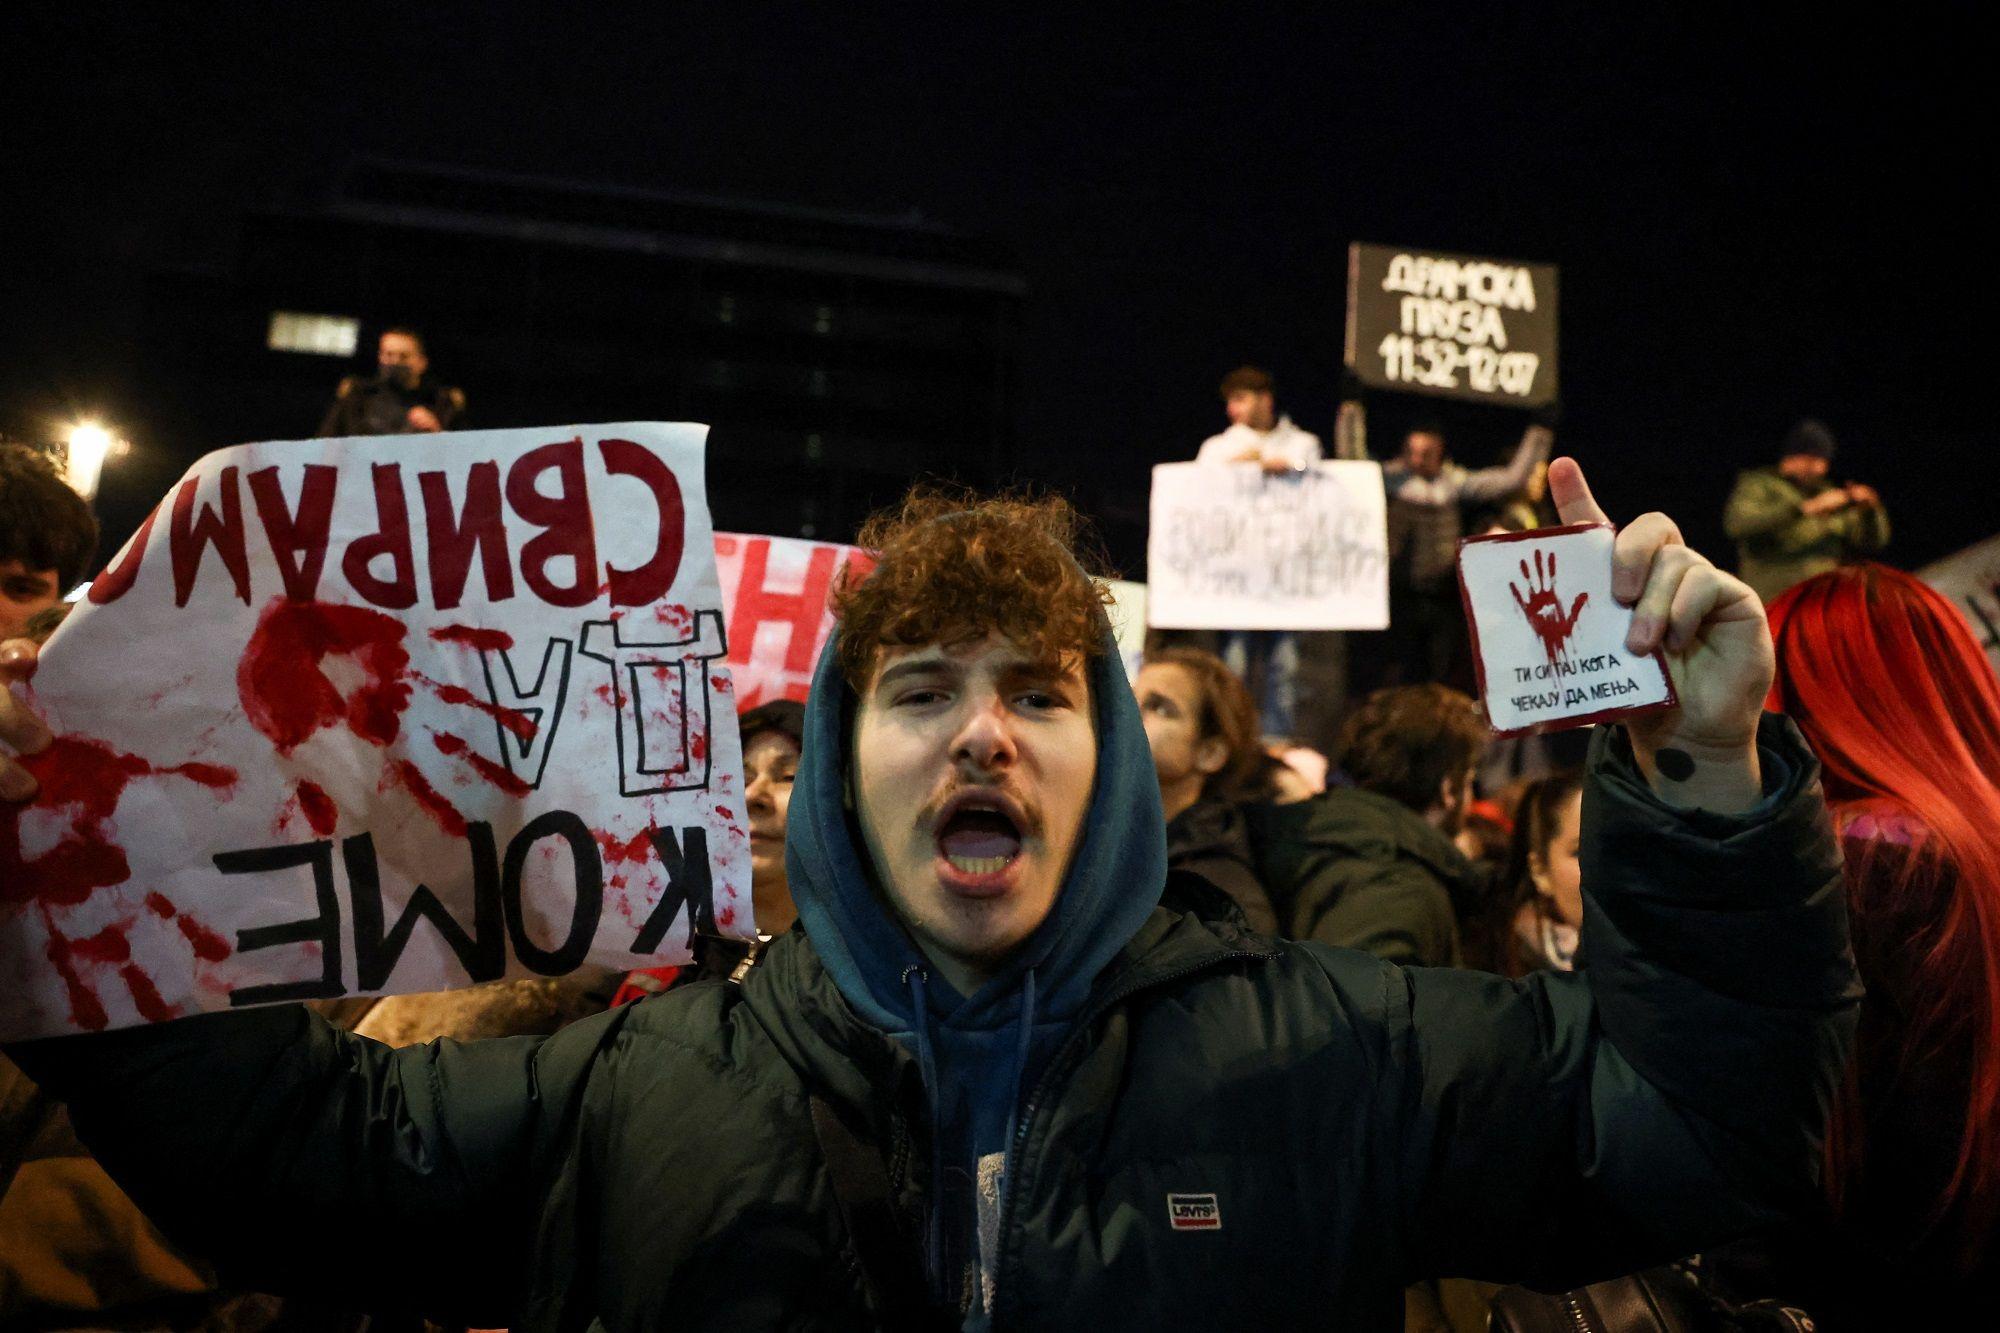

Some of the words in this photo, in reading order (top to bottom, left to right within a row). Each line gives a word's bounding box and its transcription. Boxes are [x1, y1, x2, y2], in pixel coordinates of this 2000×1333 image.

[481, 610, 728, 797] ДА
[1510, 690, 1560, 712] ЧЕКАЈУ
[1564, 686, 1588, 709] ДА
[1590, 677, 1640, 700] МЕЊА
[1514, 667, 1531, 683] ТИ
[212, 810, 715, 1005] КОМЕ
